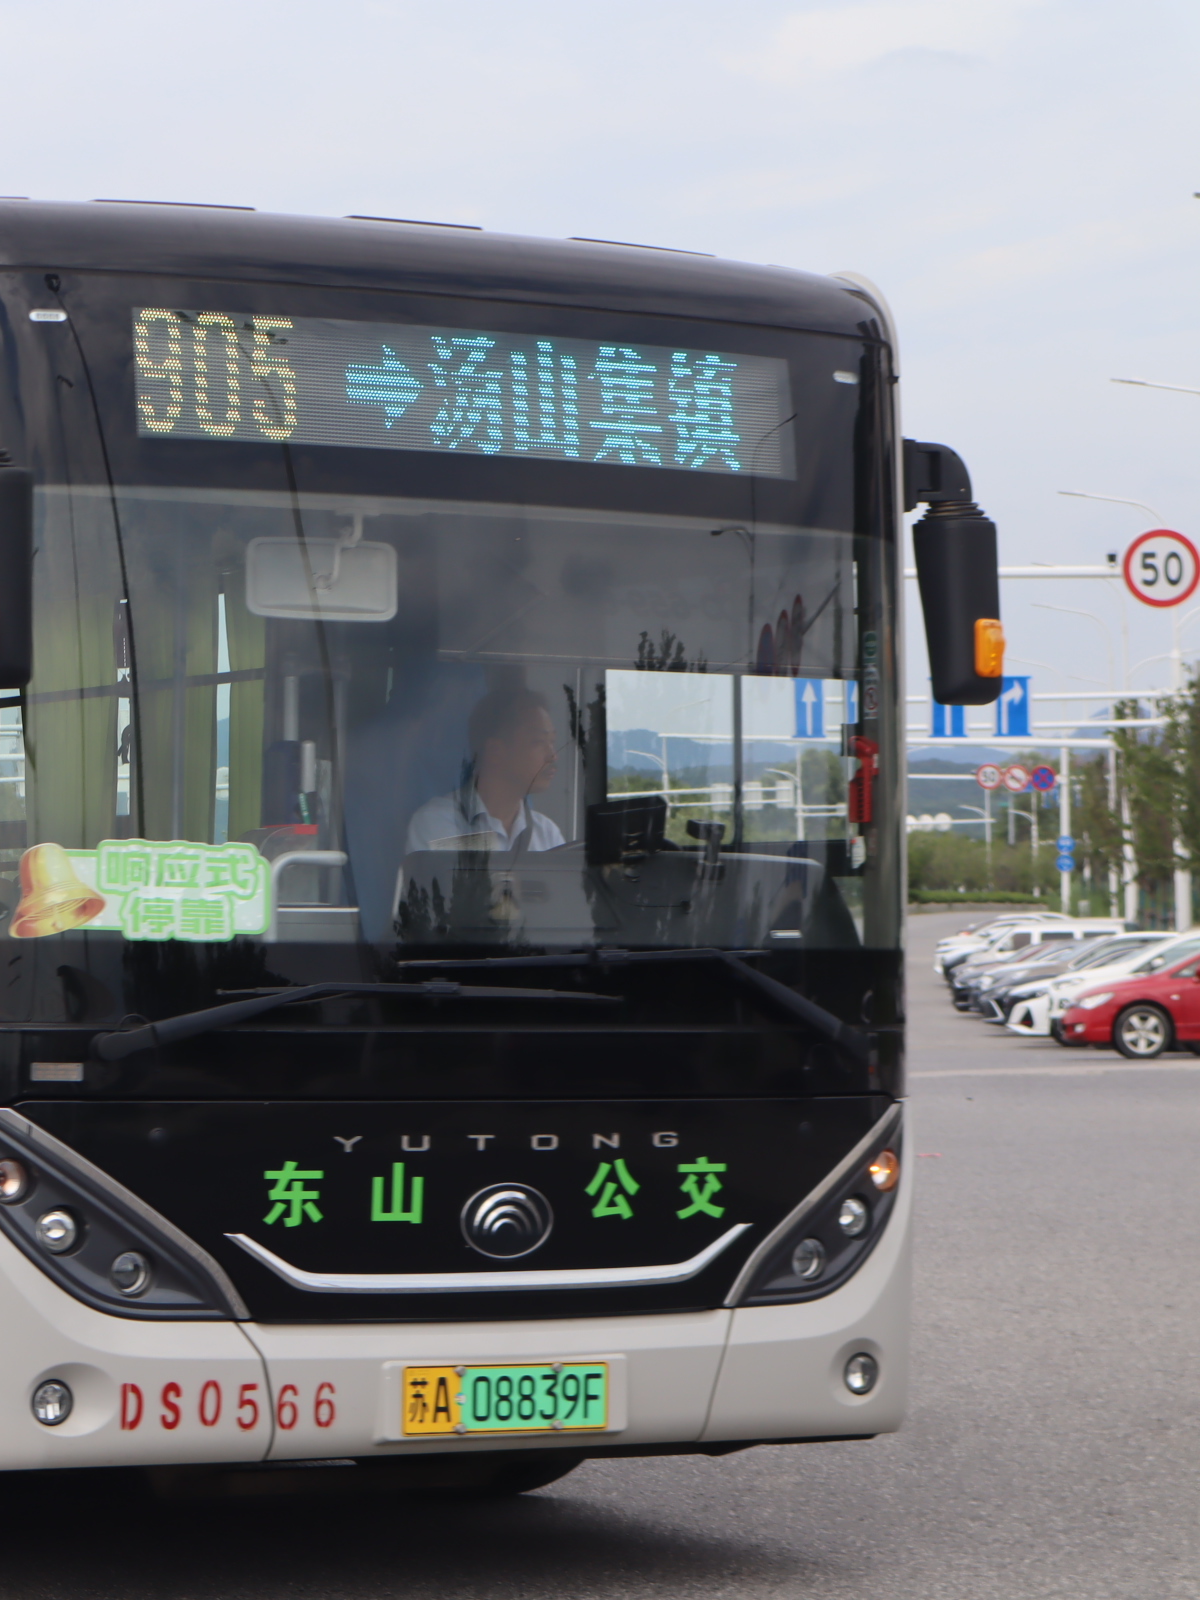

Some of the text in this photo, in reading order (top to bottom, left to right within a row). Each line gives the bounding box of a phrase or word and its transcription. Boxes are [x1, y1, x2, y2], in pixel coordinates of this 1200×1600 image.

[134, 306, 298, 441] 905
[427, 335, 741, 472] 汤山集镇
[1141, 550, 1183, 587] 50
[107, 849, 251, 891] 响应式
[129, 897, 225, 934] 停靠
[333, 1131, 680, 1153] YUTONG
[120, 1379, 337, 1432] DS0566
